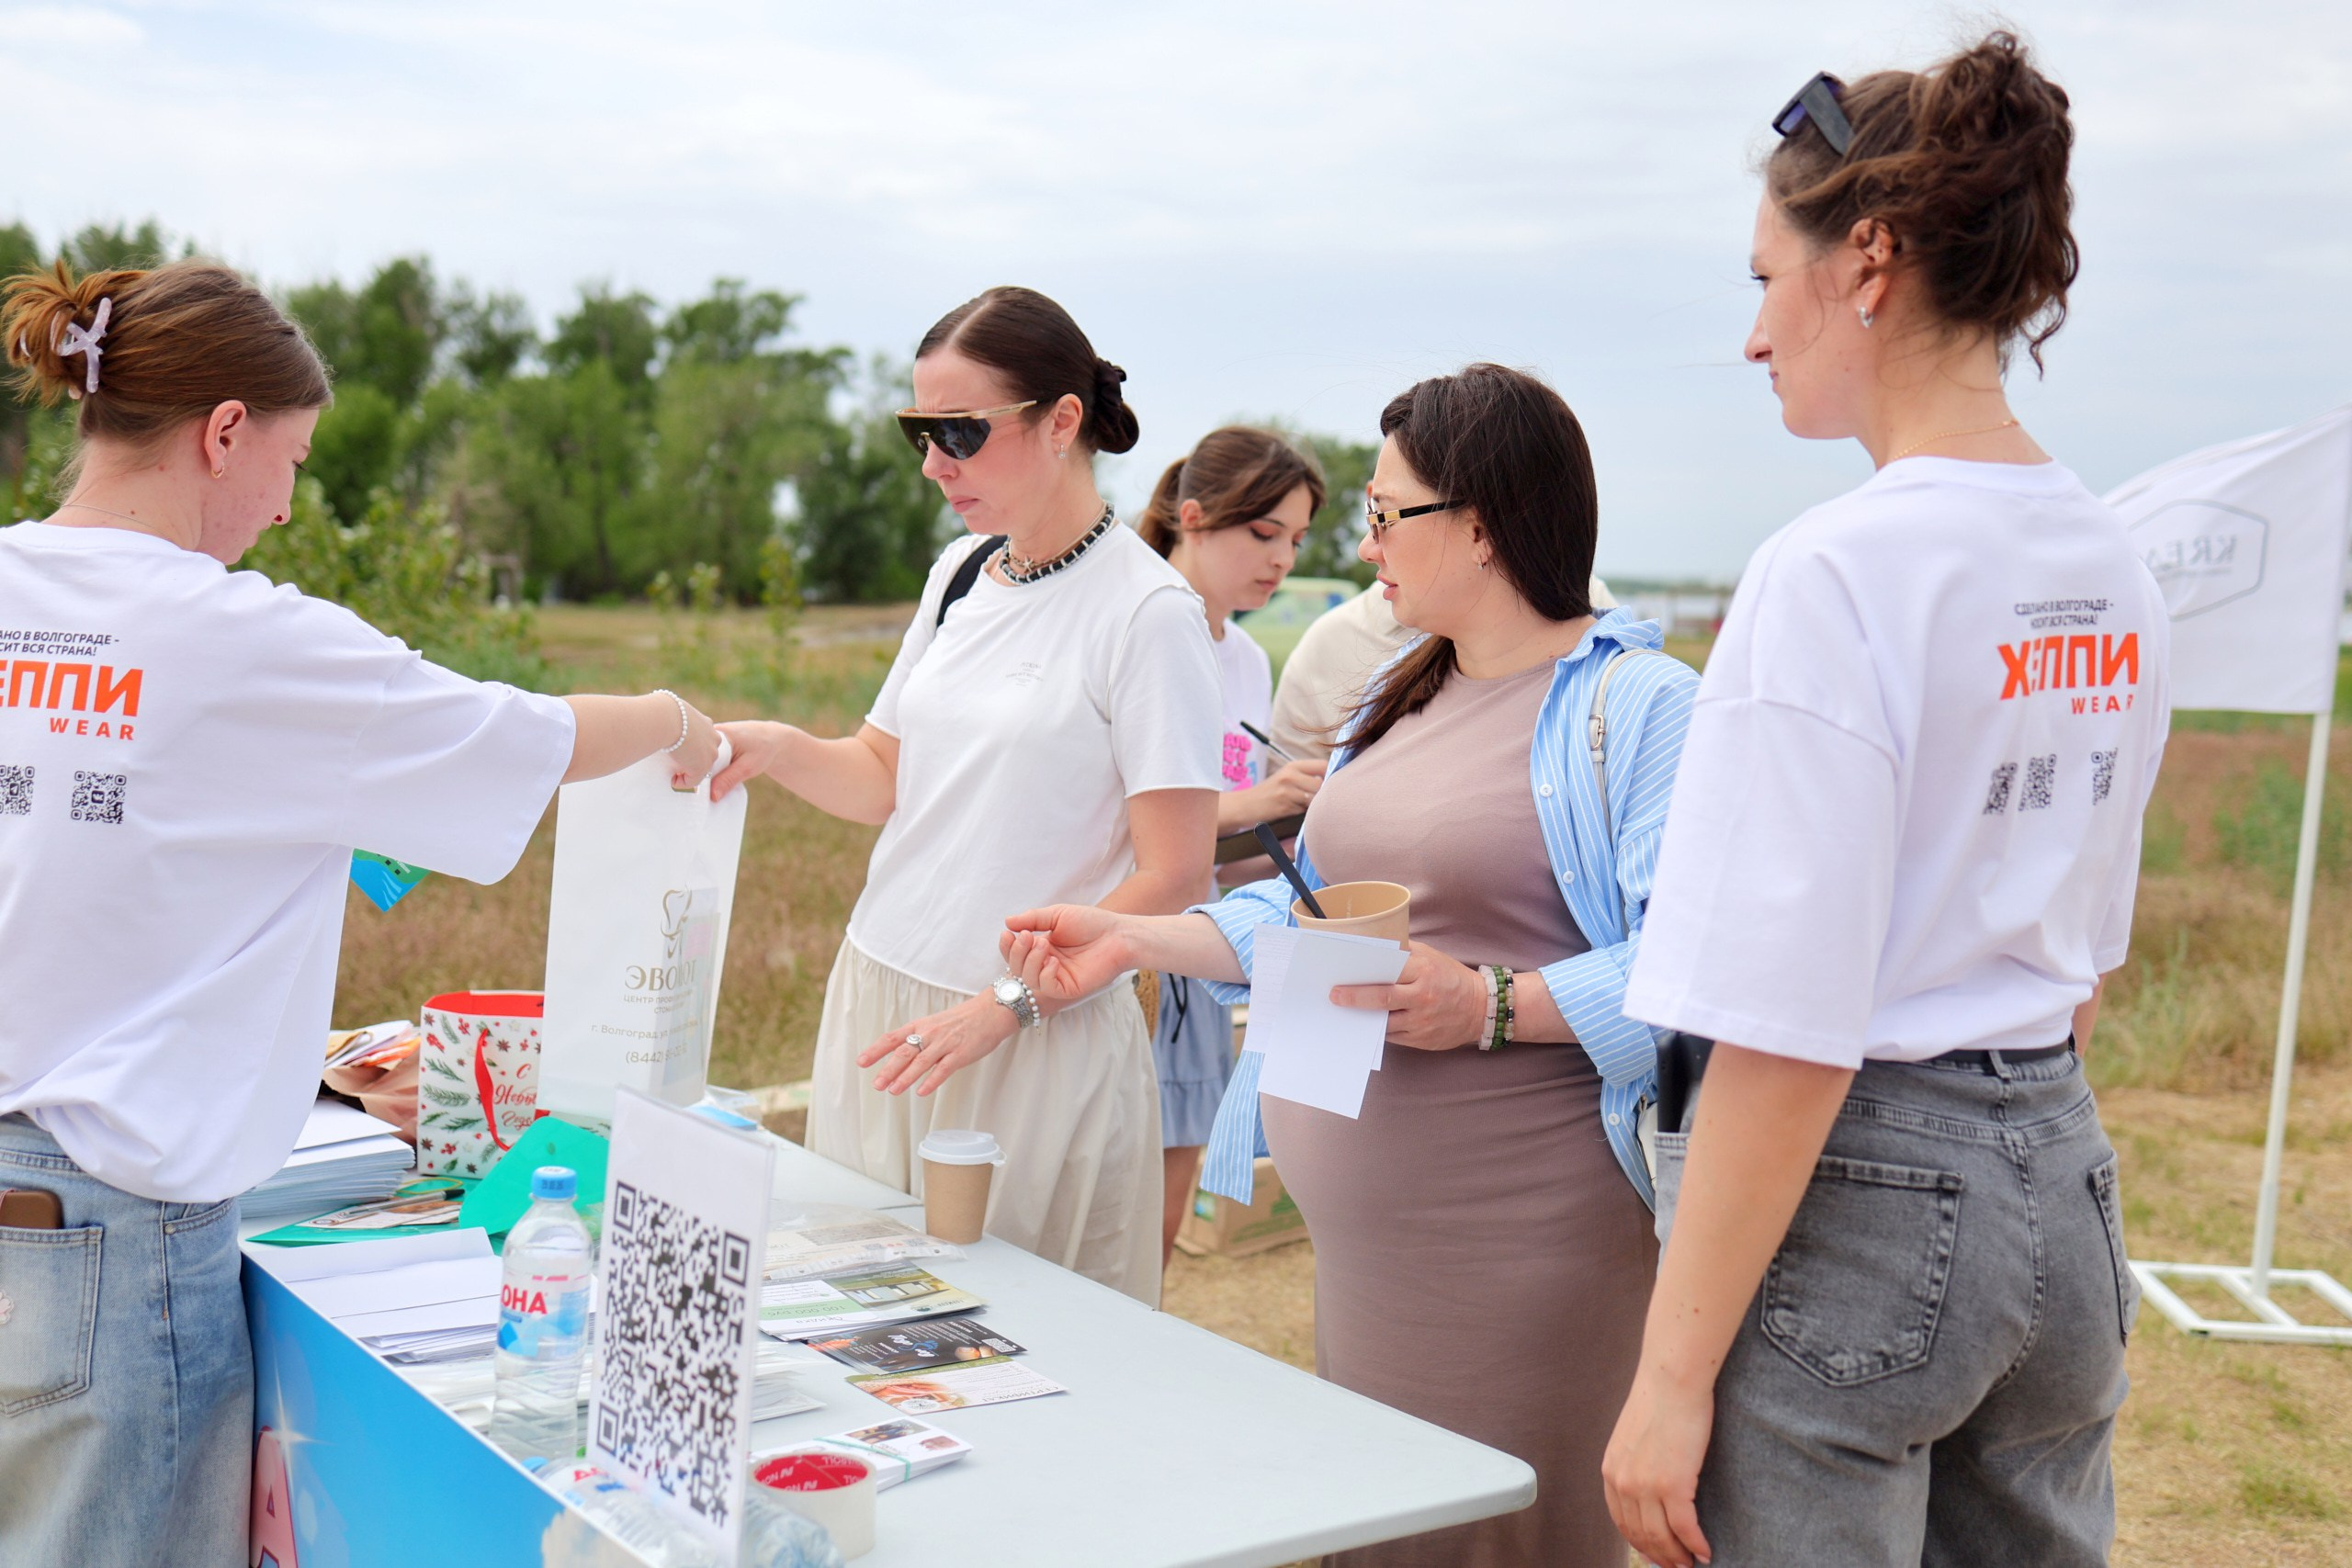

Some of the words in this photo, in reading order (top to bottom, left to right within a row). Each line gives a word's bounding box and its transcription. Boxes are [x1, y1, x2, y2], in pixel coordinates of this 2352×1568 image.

[24, 631, 31, 640] В
[33, 631, 111, 645] ВОЛГОГРАДЕ
[22, 643, 45, 653] ВСЯ
[47, 644, 96, 656] СТРАНА!
[50, 717, 135, 740] WEAR
[623, 995, 653, 1004] ЦЕНТР
[601, 1024, 658, 1040] Волгоград
